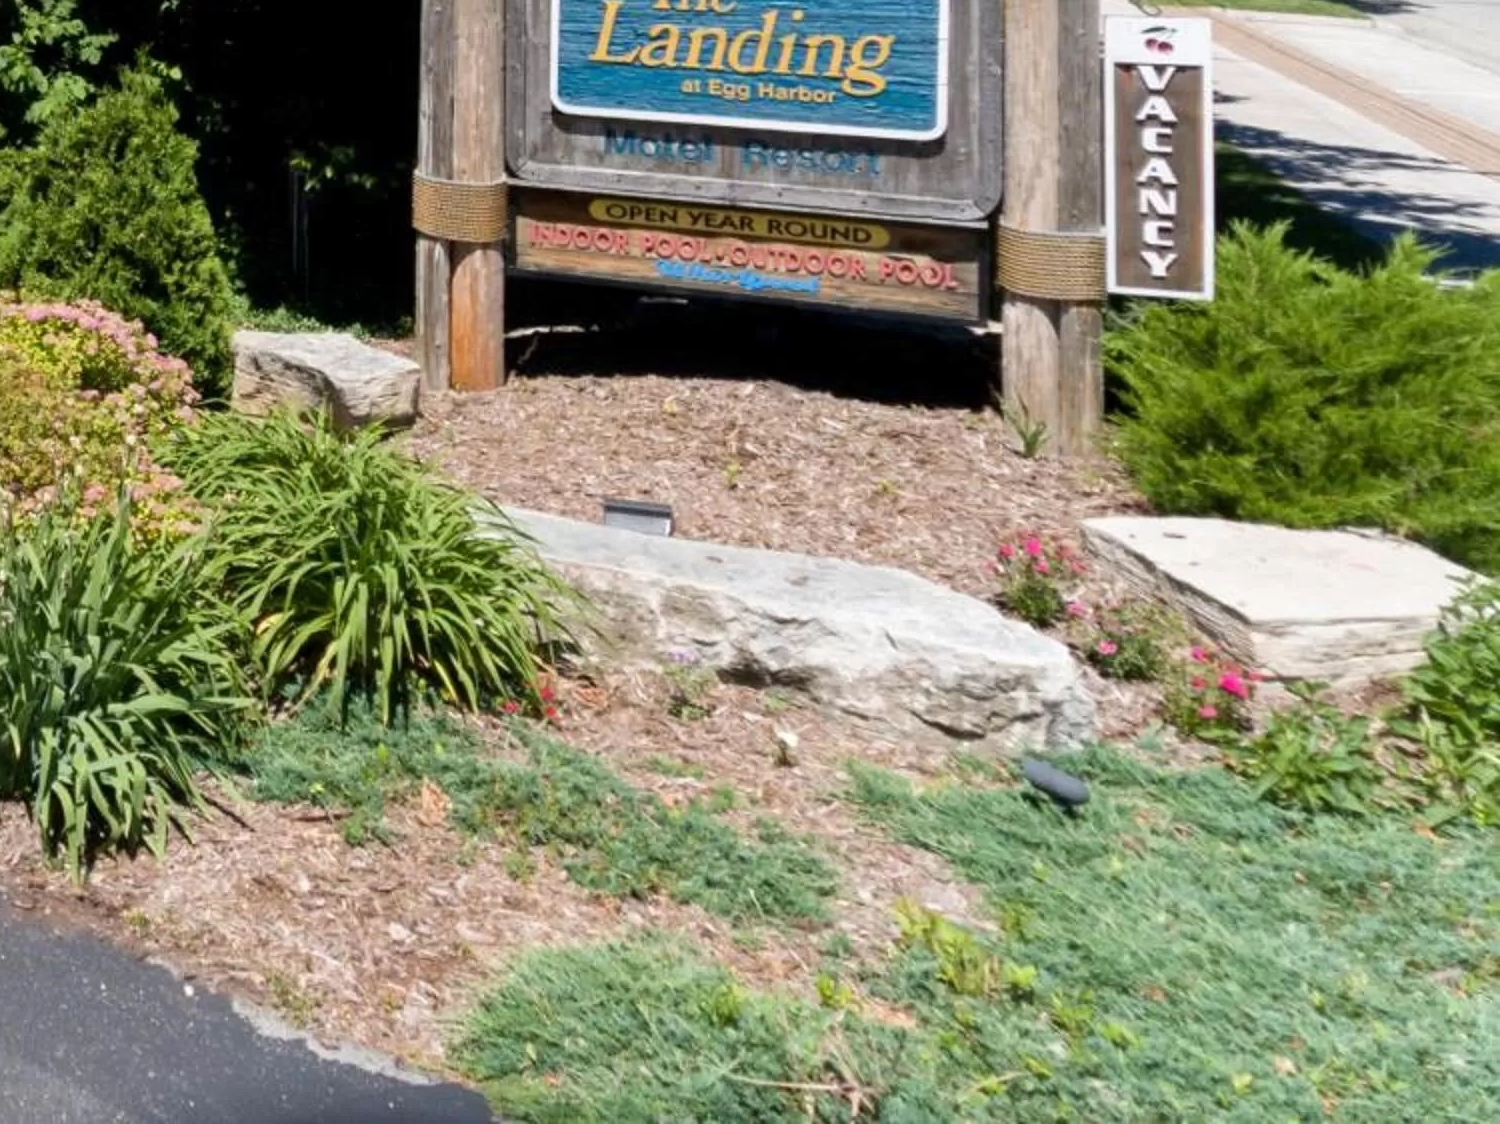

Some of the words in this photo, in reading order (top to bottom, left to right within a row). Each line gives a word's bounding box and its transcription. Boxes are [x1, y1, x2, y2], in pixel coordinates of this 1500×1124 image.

[680, 78, 701, 93] at
[707, 78, 750, 100] Egg
[757, 82, 836, 103] Harbor
[604, 128, 713, 163] Motel
[741, 139, 881, 175] Resort
[1135, 65, 1179, 277] VACANCY
[605, 203, 678, 224] OPEN
[687, 210, 755, 232] YEAR
[767, 218, 873, 244] ROUND
[529, 222, 630, 256] INDOOR
[878, 255, 960, 291] POOL
